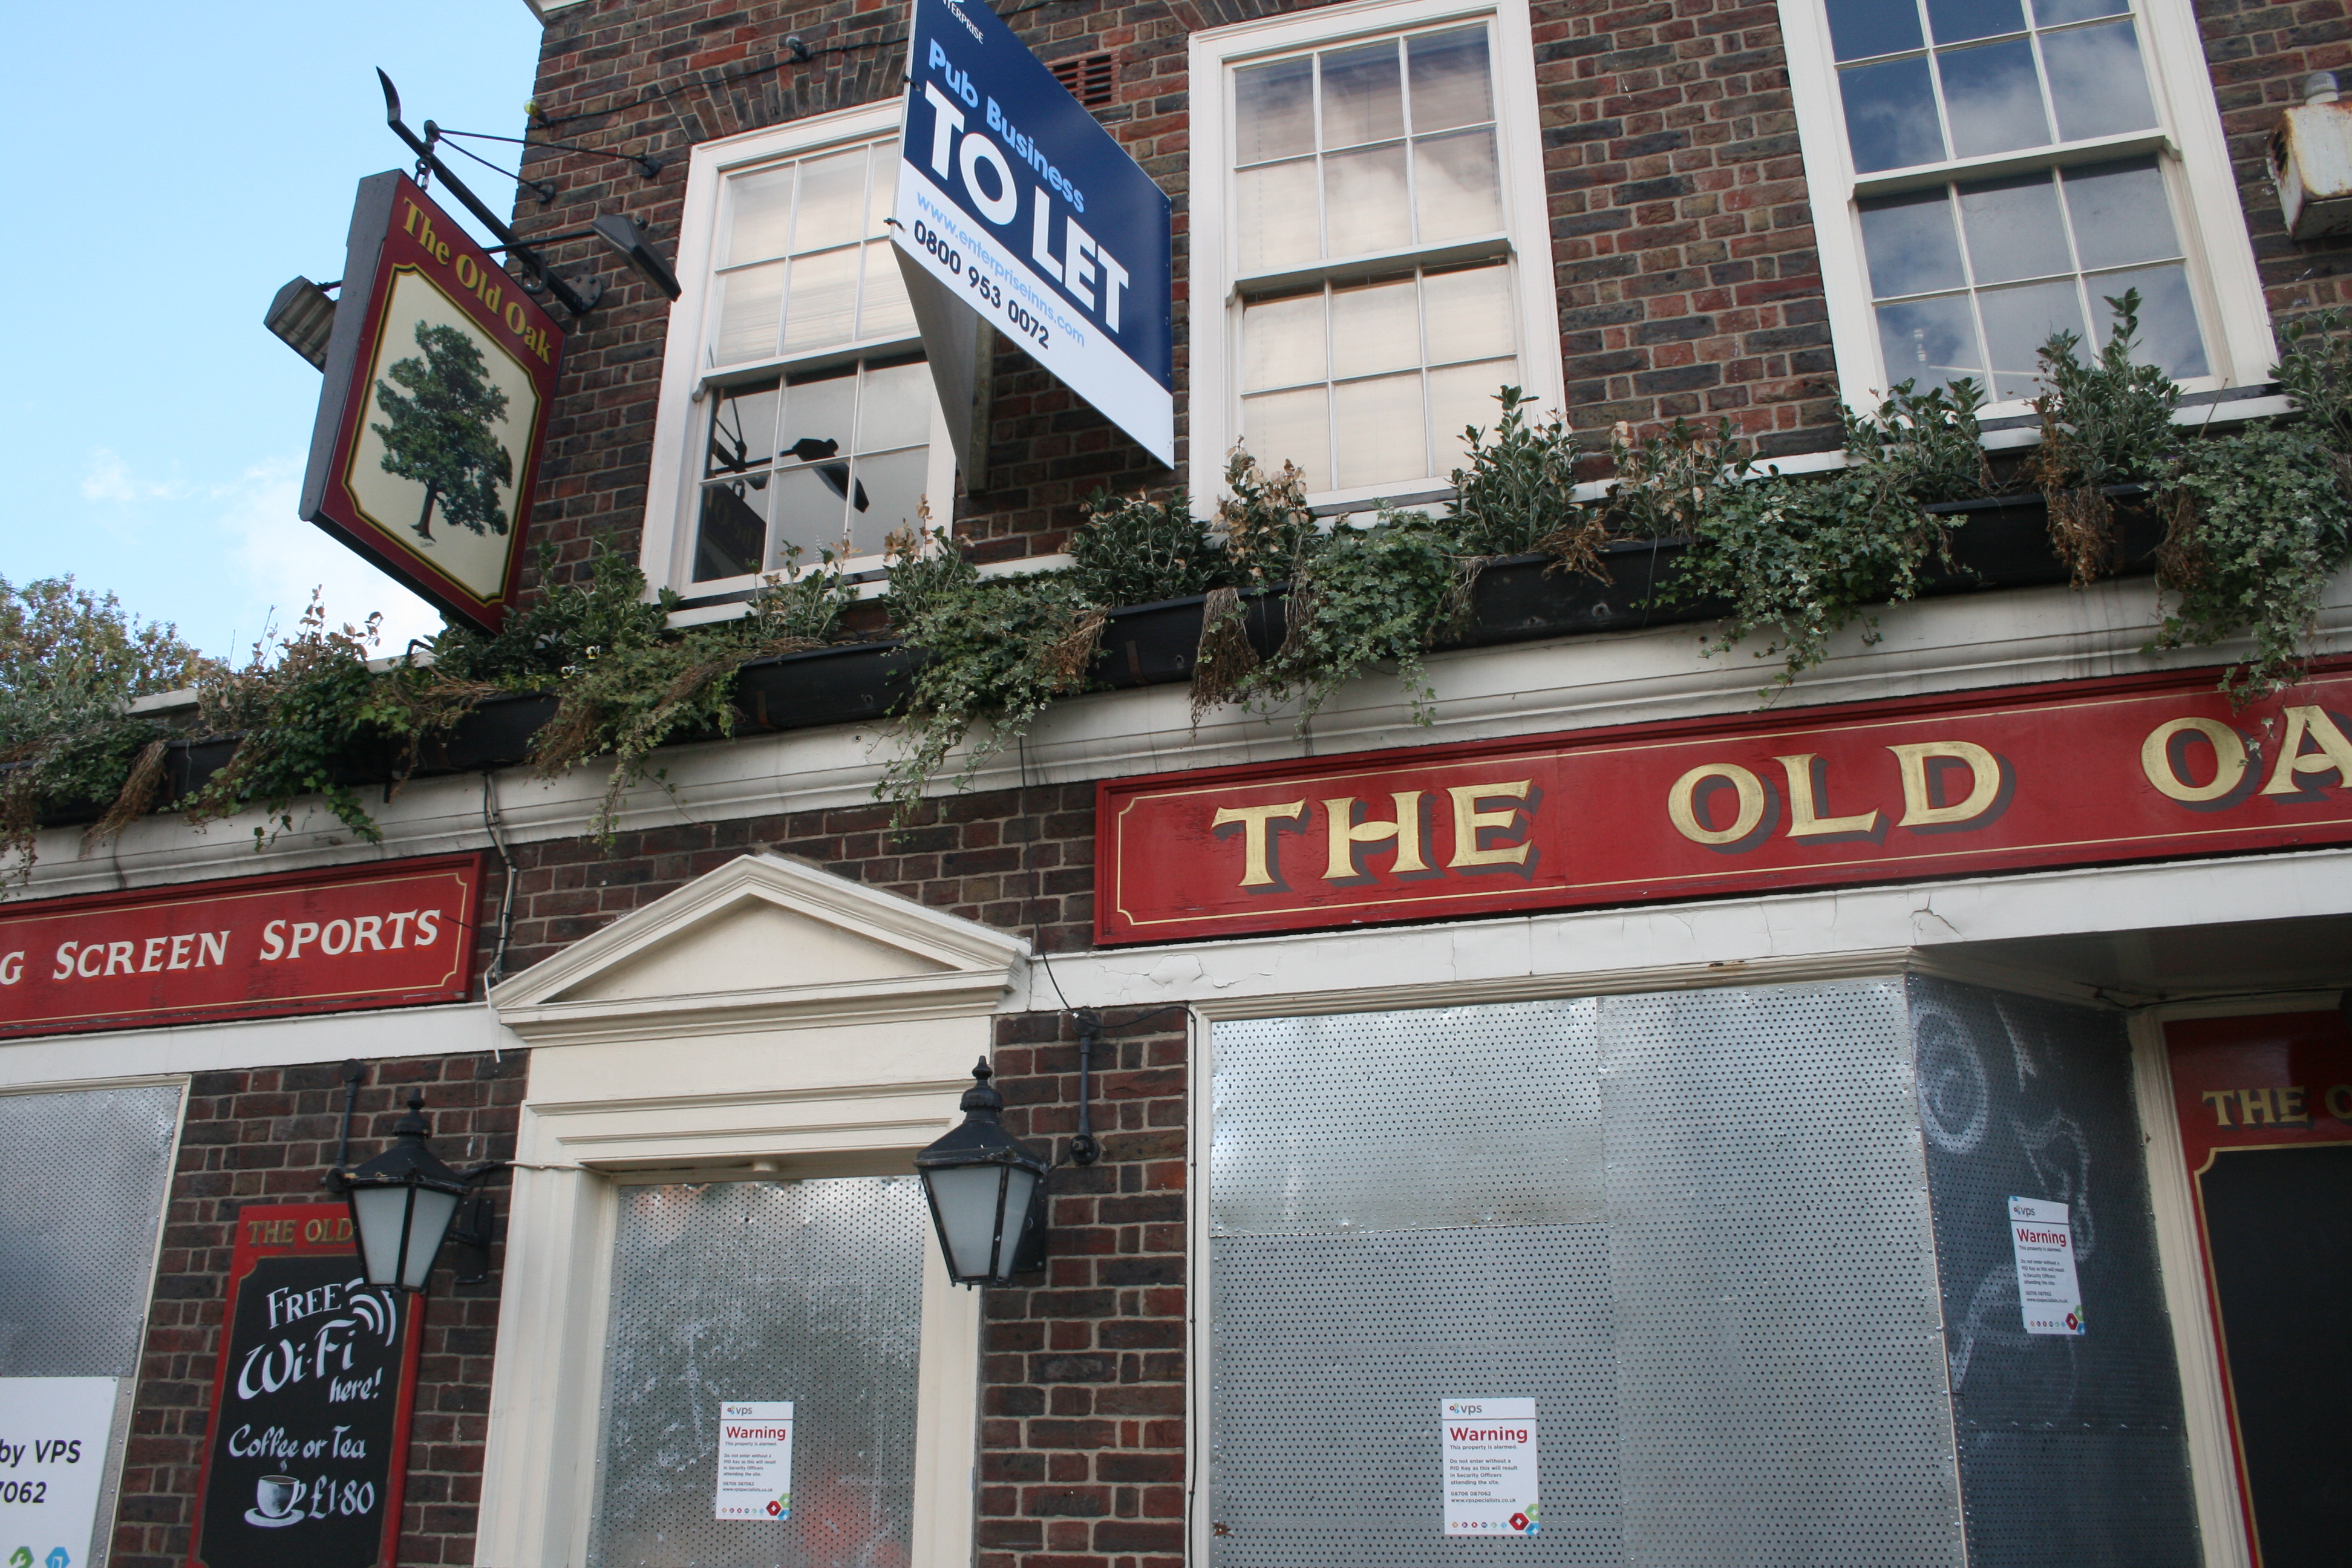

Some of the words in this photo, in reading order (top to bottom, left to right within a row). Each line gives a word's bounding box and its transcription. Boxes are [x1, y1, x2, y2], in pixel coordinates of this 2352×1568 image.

[929, 38, 978, 108] Pub
[987, 96, 1084, 213] Business
[925, 80, 1017, 226] TO
[1032, 185, 1129, 334] LET
[403, 197, 450, 265] The
[456, 254, 501, 315] Old
[505, 302, 551, 365] Oak
[914, 220, 961, 275] 0800
[968, 266, 1001, 309] 953
[1008, 299, 1049, 350] 0072
[917, 191, 1085, 347] www.enterpriseinns.com
[1211, 777, 1535, 887] THE
[1667, 740, 2003, 844] OLD
[53, 930, 231, 980] SCREEN
[260, 909, 441, 961] SPORTS
[2202, 1085, 2308, 1126] THE
[2020, 1207, 2035, 1217] vps
[248, 1219, 297, 1244] THE
[304, 1218, 354, 1242] OLD
[2016, 1228, 2066, 1247] Warning
[267, 1283, 341, 1330] FREE
[329, 1367, 382, 1403] here!
[736, 1407, 753, 1416] vps
[1460, 1405, 1482, 1415] vps
[229, 1423, 299, 1457] Coffee
[302, 1439, 328, 1458] or
[332, 1425, 367, 1459] Tea
[726, 1426, 786, 1440] Warning
[1449, 1426, 1527, 1443] Warning
[0, 1439, 26, 1468] by
[35, 1439, 82, 1463] VPS
